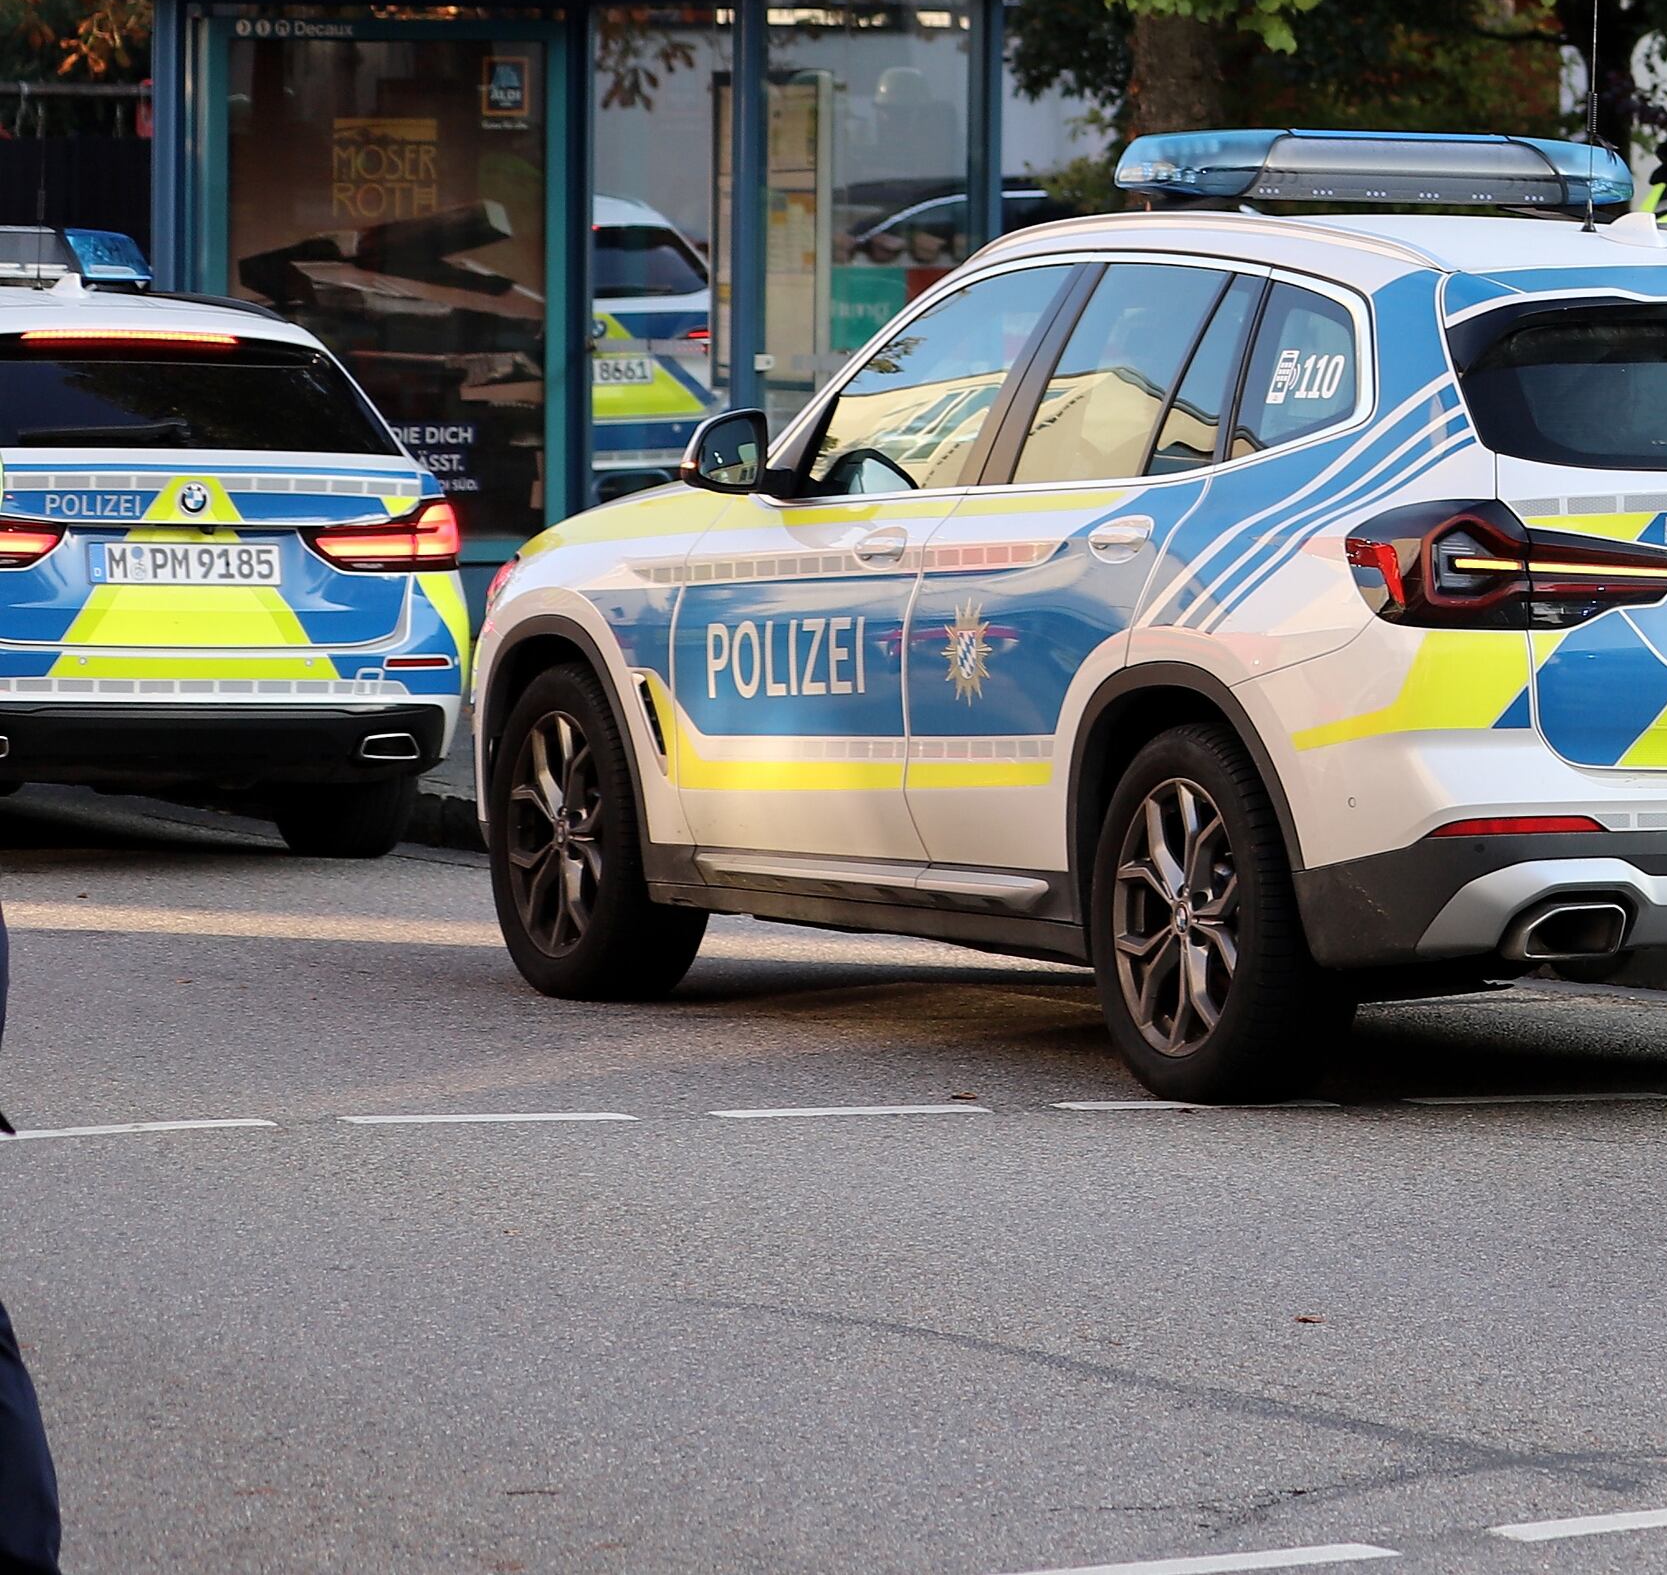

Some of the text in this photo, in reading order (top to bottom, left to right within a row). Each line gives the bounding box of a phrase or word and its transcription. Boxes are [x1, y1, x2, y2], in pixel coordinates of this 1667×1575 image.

[294, 21, 353, 36] Decaux
[333, 146, 438, 180] MOSER
[333, 183, 438, 217] ROTH
[600, 362, 648, 381] 8661
[1295, 355, 1345, 398] 110
[425, 427, 473, 444] DICH
[419, 450, 464, 471] ÄSST.
[45, 494, 141, 516] POLIZEI
[108, 547, 274, 579] M PM 9185
[707, 616, 866, 700] POLIZEI
